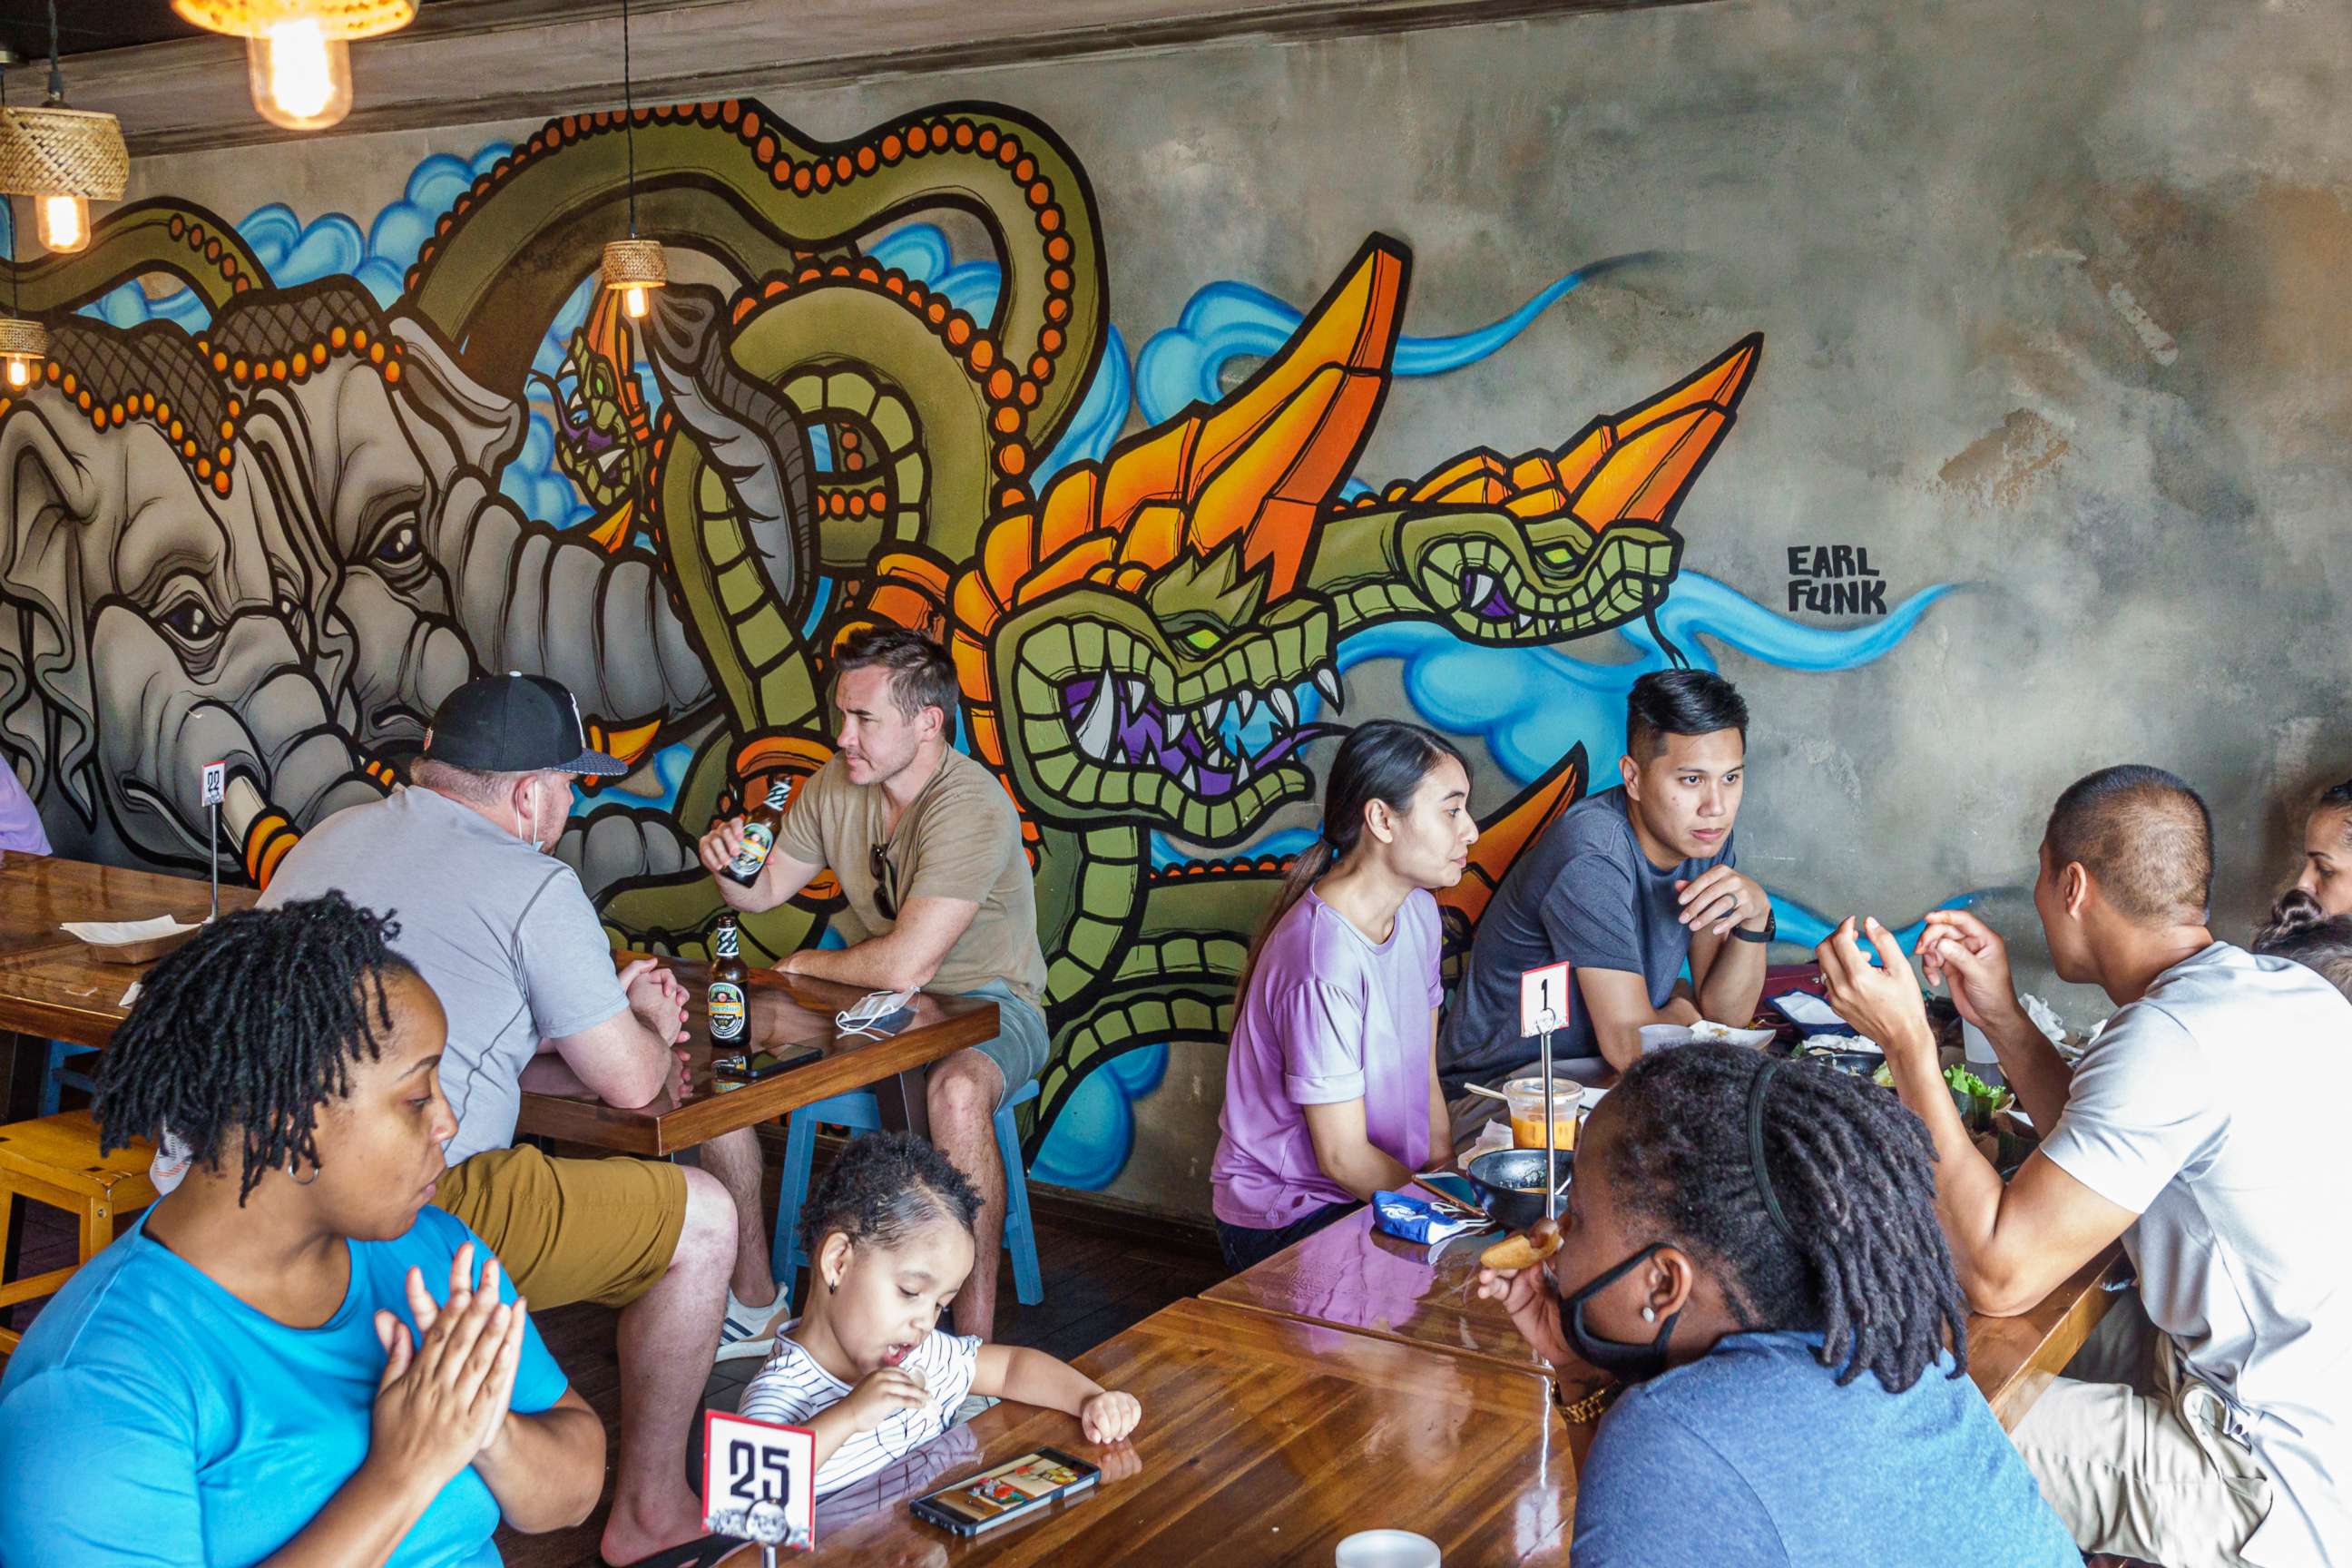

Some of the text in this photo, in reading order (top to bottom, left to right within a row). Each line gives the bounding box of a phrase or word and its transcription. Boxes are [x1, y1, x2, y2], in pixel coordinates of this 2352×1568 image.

[1788, 544, 1879, 578] EARL
[1788, 579, 1887, 615] FUNK
[208, 769, 220, 792] 22
[1541, 978, 1548, 1011] 1
[730, 1439, 789, 1510] 25
